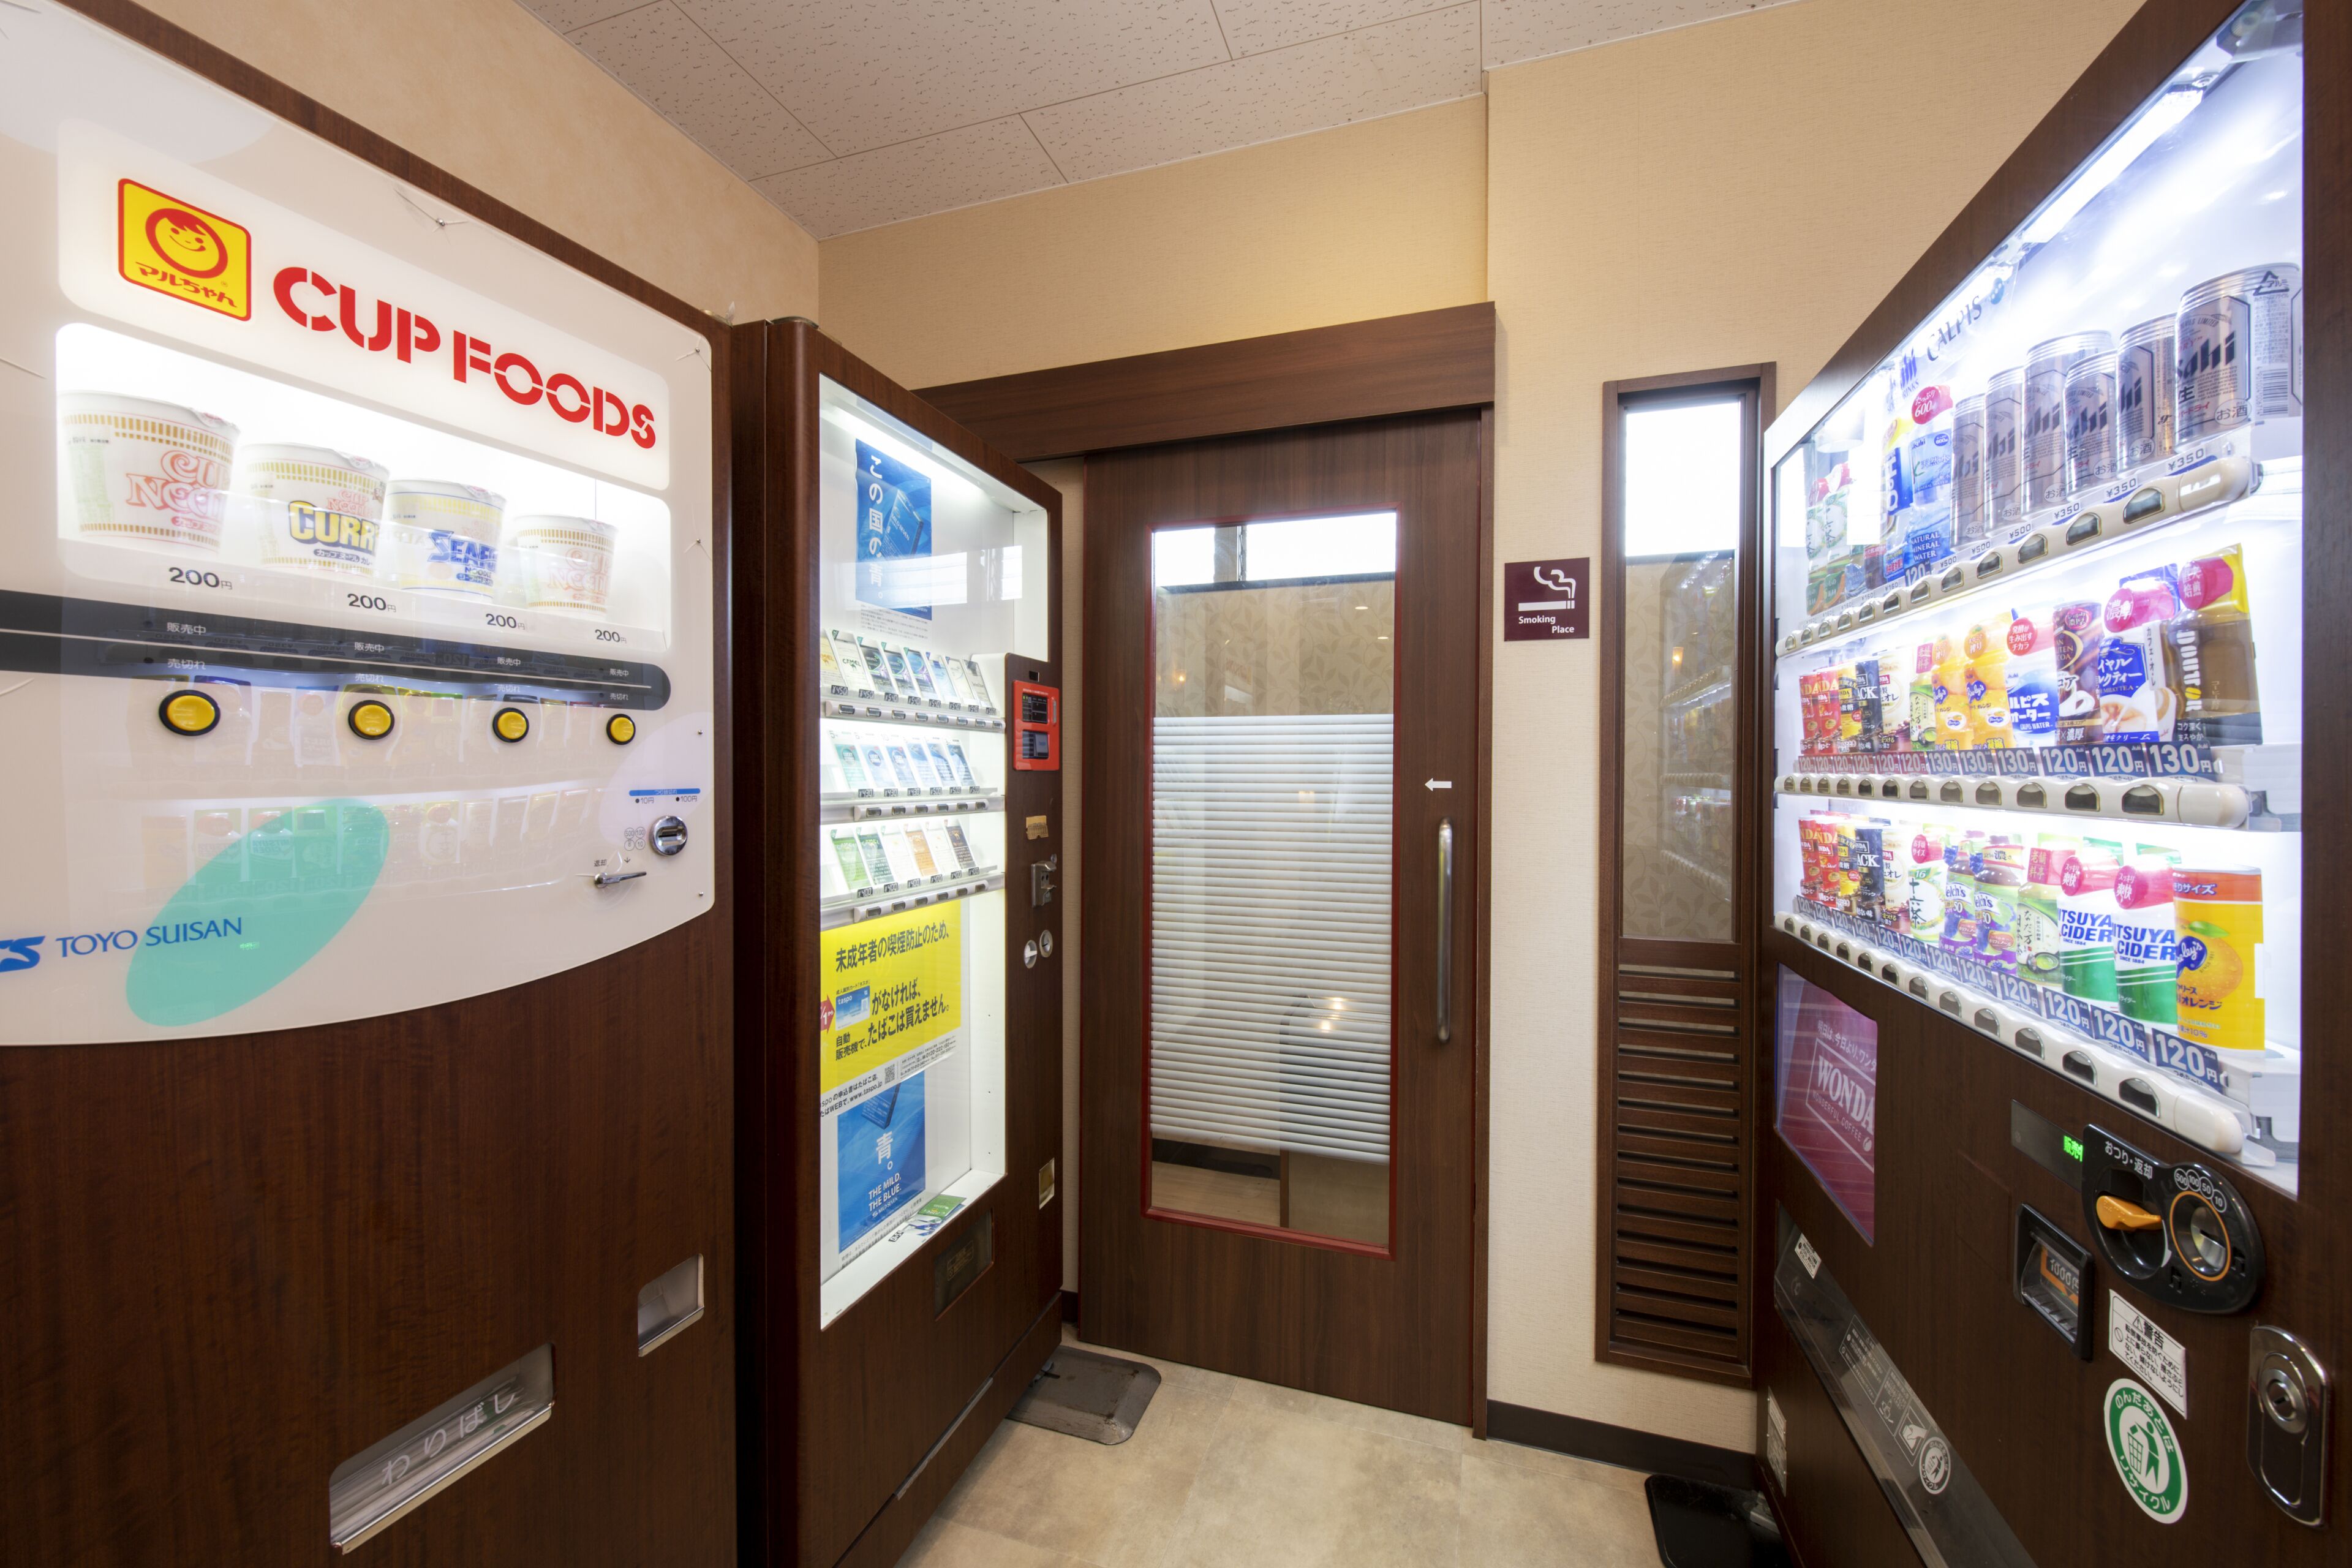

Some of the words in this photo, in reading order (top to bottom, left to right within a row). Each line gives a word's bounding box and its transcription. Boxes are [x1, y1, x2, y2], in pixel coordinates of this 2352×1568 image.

[135, 262, 238, 310] マルちゃん
[1926, 295, 1983, 362] CALPIS
[273, 266, 442, 364] CUP
[453, 331, 656, 450] FOODS
[2215, 404, 2248, 421] お酒
[2129, 442, 2152, 457] お酒
[2168, 447, 2205, 471] ¥350
[2094, 463, 2117, 477] お酒
[2106, 478, 2137, 497] ¥350
[2054, 502, 2081, 520] ¥350
[288, 500, 380, 556] CURR
[869, 454, 884, 599] この国の、青。
[2009, 522, 2032, 540] ¥500
[1914, 550, 1937, 562] WATER
[1971, 541, 1991, 554] ¥500
[1940, 556, 1958, 568] ¥500
[168, 567, 233, 590] 200円
[347, 593, 397, 613] 200円
[2106, 598, 2133, 622] 濃厚
[167, 622, 207, 635] 販売中
[485, 612, 526, 631] 200円
[1518, 615, 1556, 625] Smoking
[1551, 625, 1575, 634] Place
[594, 628, 628, 644] 200円
[2008, 633, 2033, 644] 生み出す
[353, 641, 385, 653] 販売中
[2011, 642, 2030, 652] チカラ
[167, 658, 207, 671] 売切れ
[497, 657, 521, 667] 販売中
[2098, 657, 2133, 672] イヤル
[2177, 631, 2202, 712] DOUTOR
[354, 673, 385, 684] 売切れ
[609, 668, 630, 677] 販売中
[497, 684, 521, 693] 売切れ
[609, 692, 630, 701] 売切れ
[1877, 755, 1899, 772] 120円
[1901, 753, 1927, 772] 120円
[1929, 752, 1959, 772] 130円
[1961, 752, 1996, 772] 130円
[1997, 749, 2037, 774] 130円
[2042, 748, 2086, 774] 120円
[2092, 746, 2144, 774] 120円
[2149, 744, 2213, 774] 130円
[1912, 848, 1925, 857] サイズ
[2062, 873, 2076, 888] 爽快
[2118, 873, 2135, 883] スッキリ
[2117, 884, 2133, 902] 爽快
[1909, 878, 1927, 929] 十六茶
[1953, 902, 1962, 913] 50
[2023, 910, 2033, 945] なだ万
[2059, 908, 2112, 929] ITSUYA
[56, 930, 138, 958] TOYO
[145, 916, 243, 947] SUISAN
[1876, 927, 1899, 949] 120円
[2061, 924, 2113, 943] CIDER
[2113, 923, 2176, 944] ITSUYA
[835, 920, 949, 973] 未成年者の喫煙防止のため、
[1901, 937, 1927, 962] 120円
[2117, 942, 2176, 961] CIDER
[1929, 946, 1958, 974] 120円
[1961, 959, 1994, 990] 120円
[838, 995, 853, 1005] taspo
[872, 978, 921, 1016] がなければ、
[2001, 974, 2038, 1008] 120円
[2045, 991, 2089, 1028] 120円
[835, 1031, 850, 1047] 自動
[2093, 1011, 2145, 1052] 120円
[2155, 1034, 2218, 1084] 120円
[1817, 1054, 1875, 1136] WONDA
[1812, 1091, 1839, 1123] WONDERFUL
[1841, 1116, 1861, 1143] COFFEE
[876, 1131, 894, 1170] 青。
[2104, 1140, 2154, 1180] おつり・返却
[869, 1186, 882, 1200] THE
[2176, 1173, 2187, 1186] 500
[2188, 1174, 2199, 1187] 100
[2202, 1183, 2211, 1194] 50
[2214, 1196, 2223, 1207] 10
[869, 1198, 882, 1212] THE
[2143, 1320, 2165, 1351] 警告
[2124, 1351, 2153, 1382] てください。
[2114, 1390, 2174, 1453] のんだあとは
[381, 1392, 516, 1486] わりばし
[2119, 1455, 2171, 1512] リサイクル
